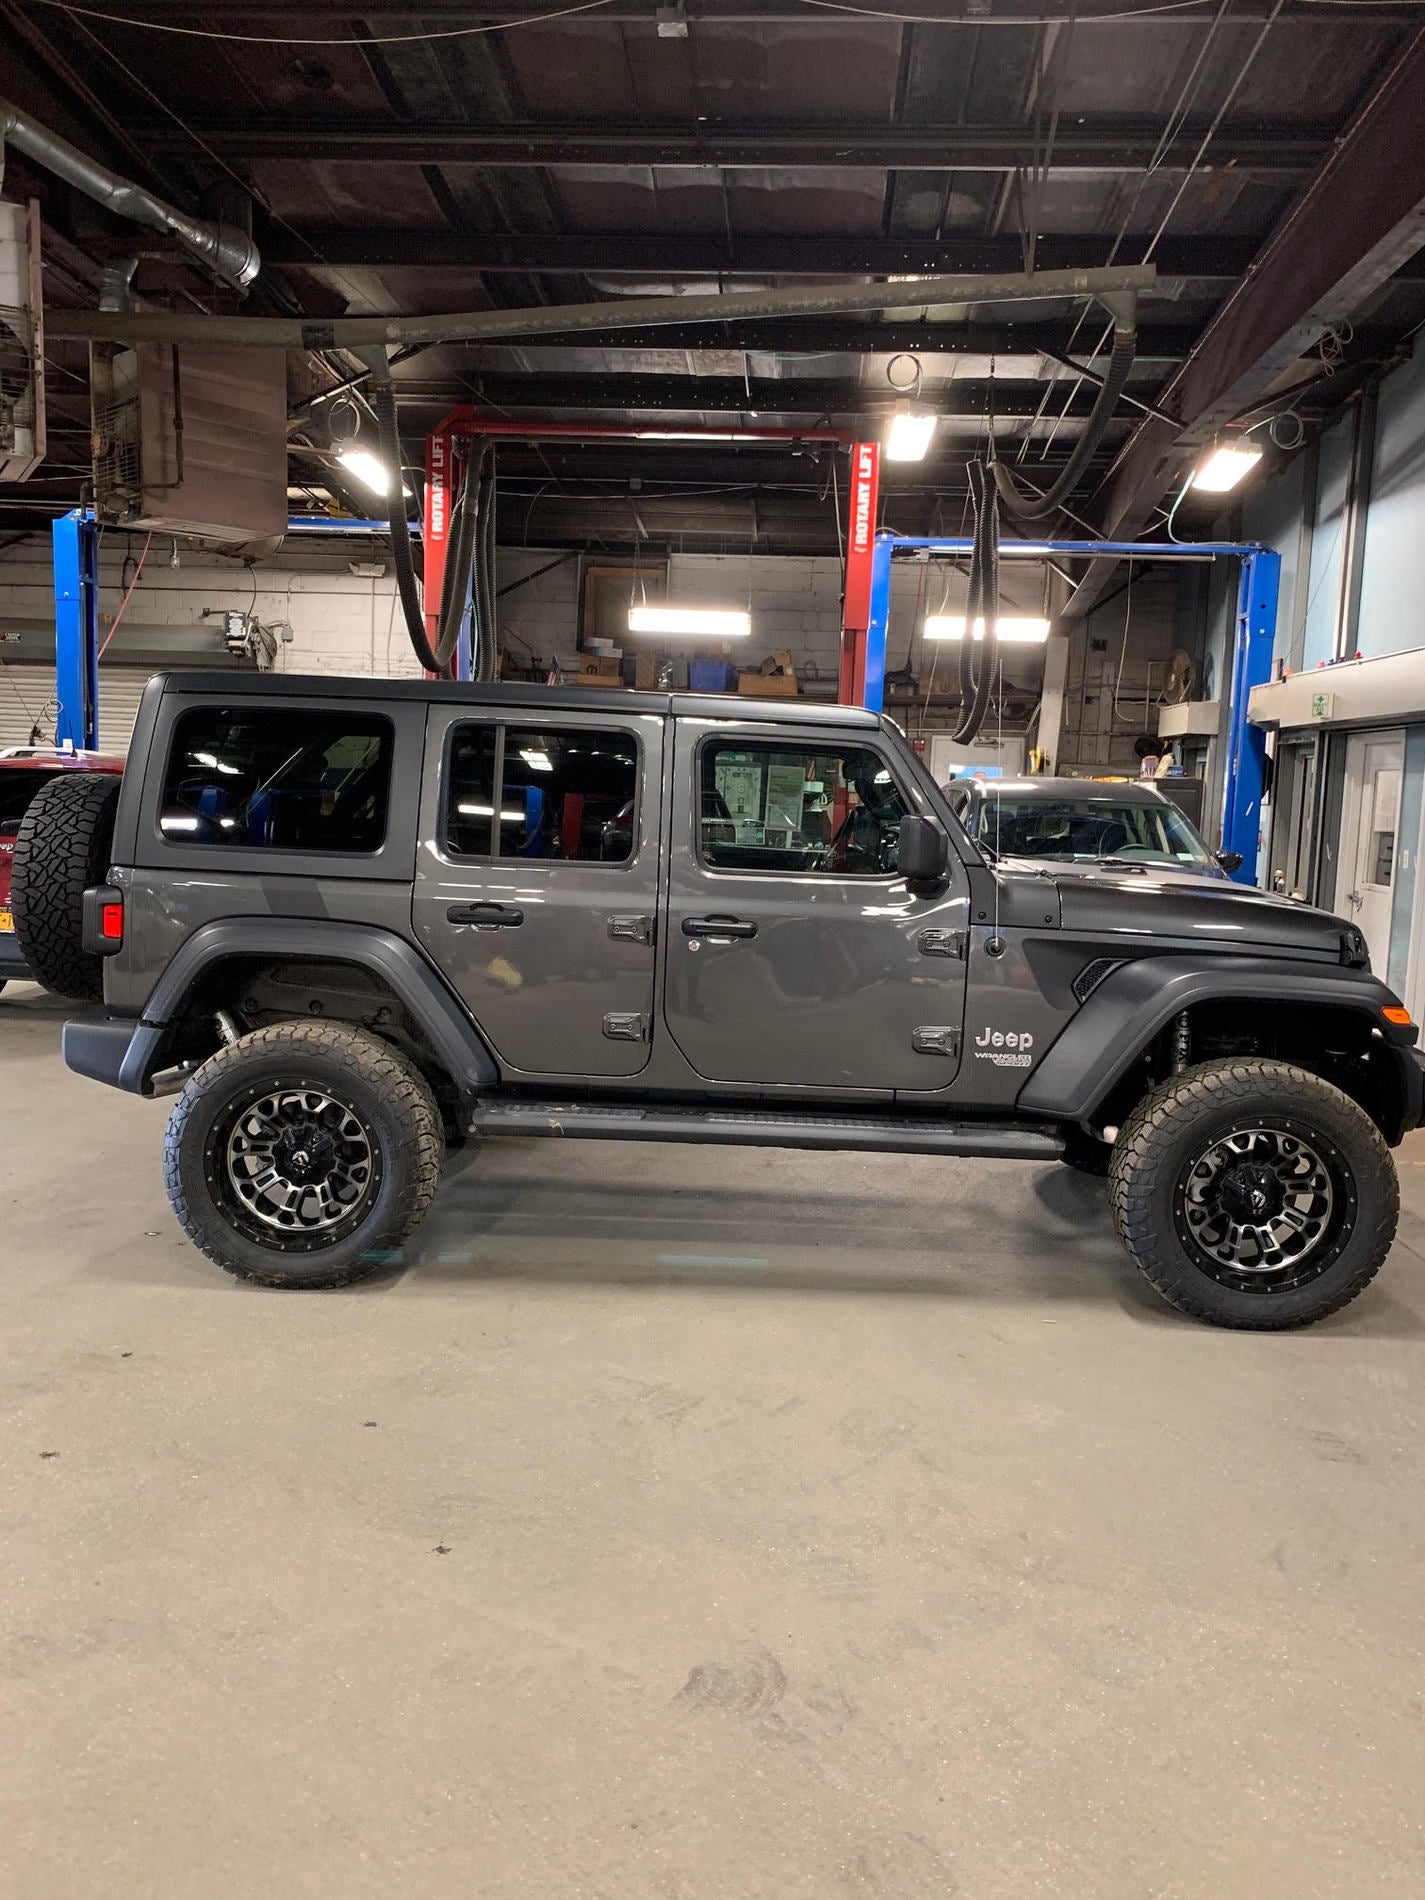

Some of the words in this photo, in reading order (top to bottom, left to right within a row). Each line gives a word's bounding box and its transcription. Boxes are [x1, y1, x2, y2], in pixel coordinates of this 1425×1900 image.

[432, 435, 444, 468] LIFT
[858, 444, 873, 479] LIFT
[431, 472, 444, 532] ROTARY
[855, 482, 871, 545] ROTARY
[975, 1027, 1034, 1052] Jeep
